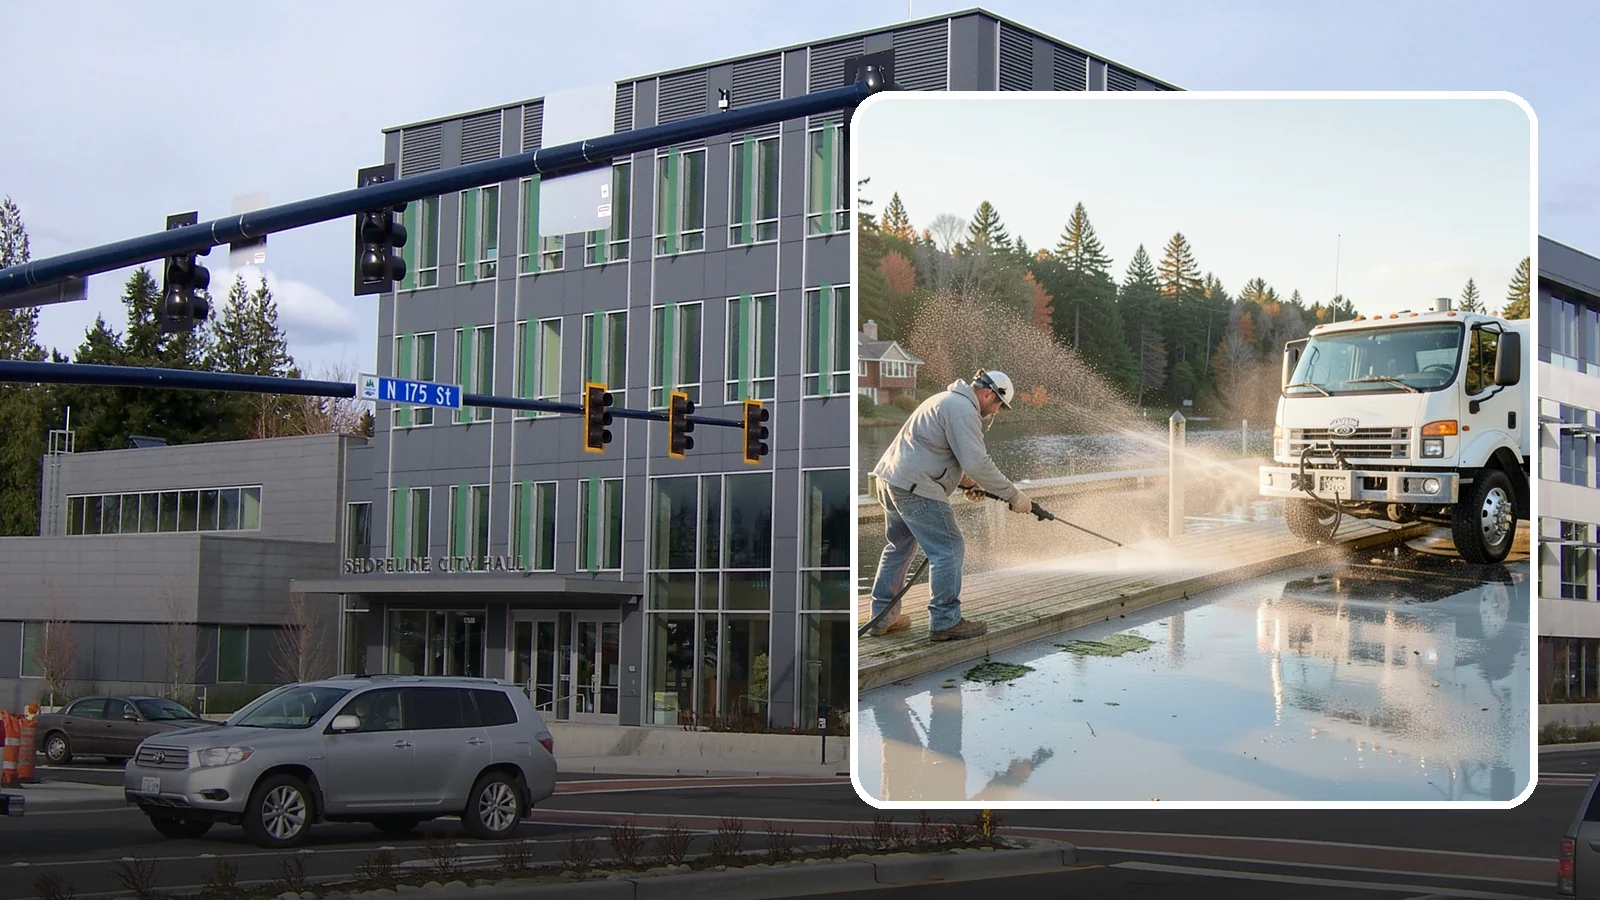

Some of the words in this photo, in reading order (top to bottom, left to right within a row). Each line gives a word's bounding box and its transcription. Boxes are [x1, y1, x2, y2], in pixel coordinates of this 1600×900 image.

[387, 380, 396, 400] N
[405, 382, 428, 403] 175
[436, 386, 452, 406] St
[344, 556, 432, 574] SHORELINE
[439, 556, 475, 572] CITY
[484, 555, 526, 571] HALL
